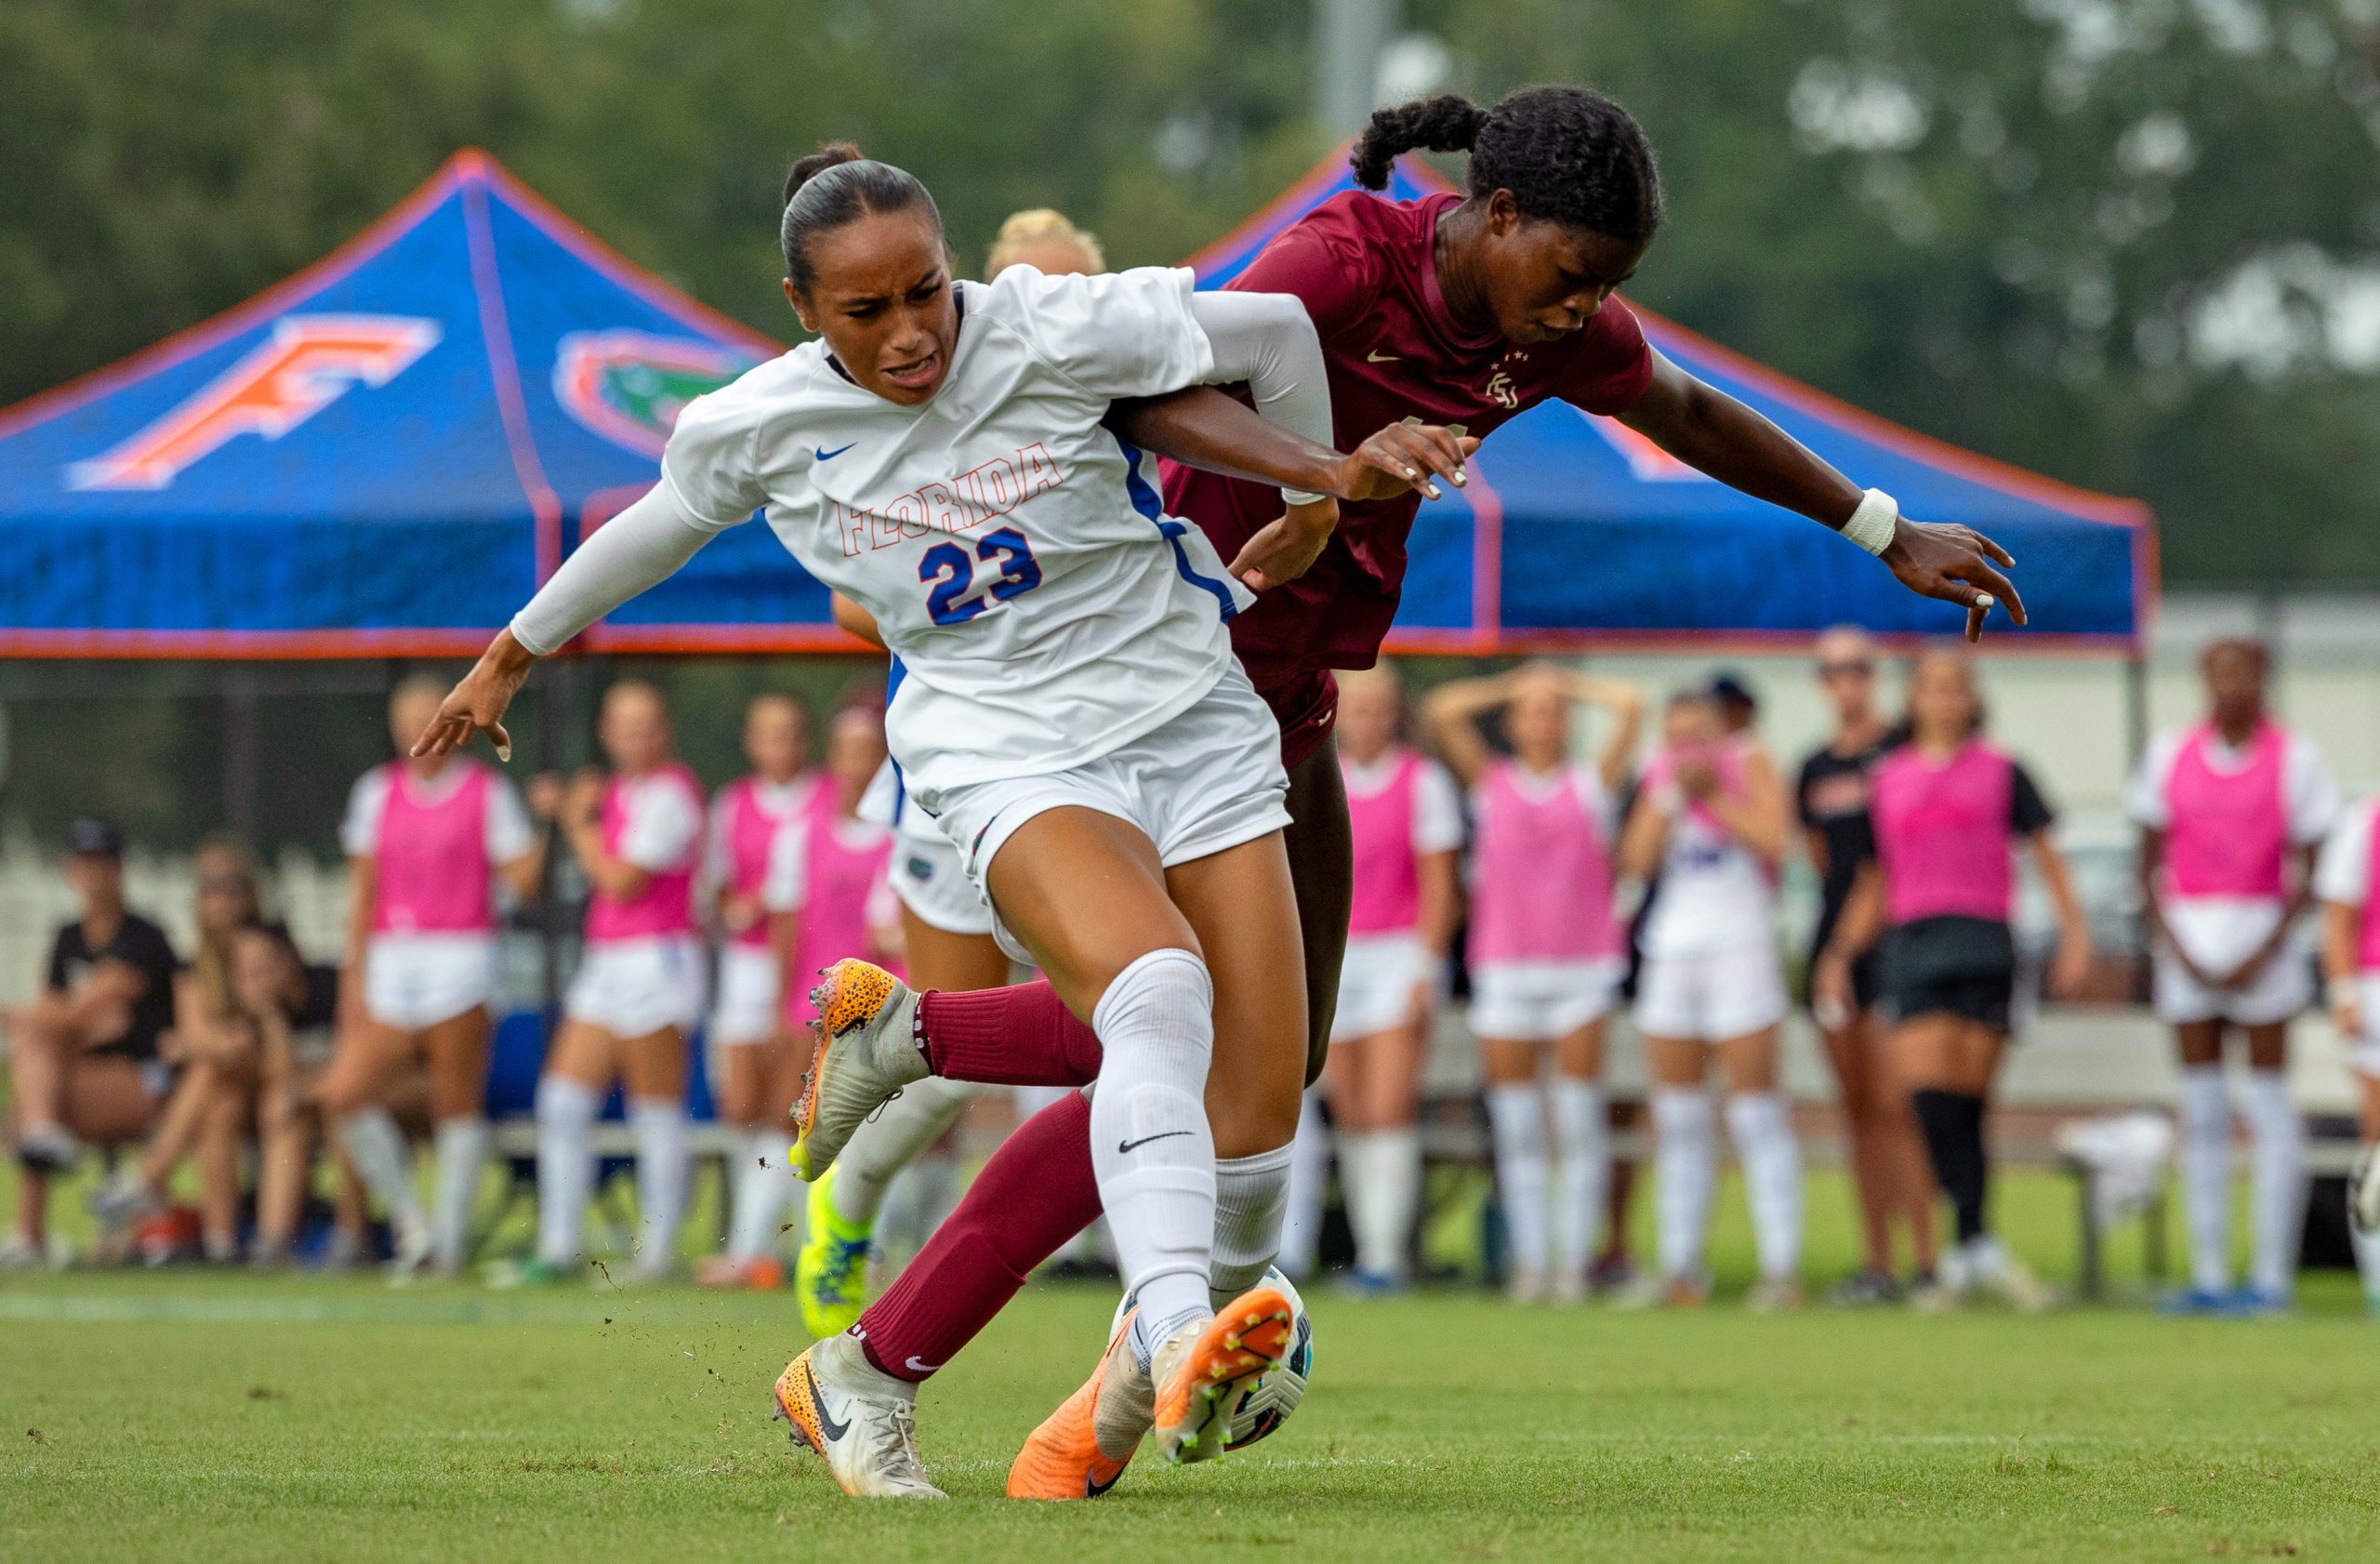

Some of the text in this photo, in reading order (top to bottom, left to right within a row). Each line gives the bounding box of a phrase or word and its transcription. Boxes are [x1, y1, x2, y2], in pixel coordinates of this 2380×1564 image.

[65, 314, 442, 491] F
[834, 442, 1063, 557] FLORIDA
[918, 526, 1042, 626] 23
